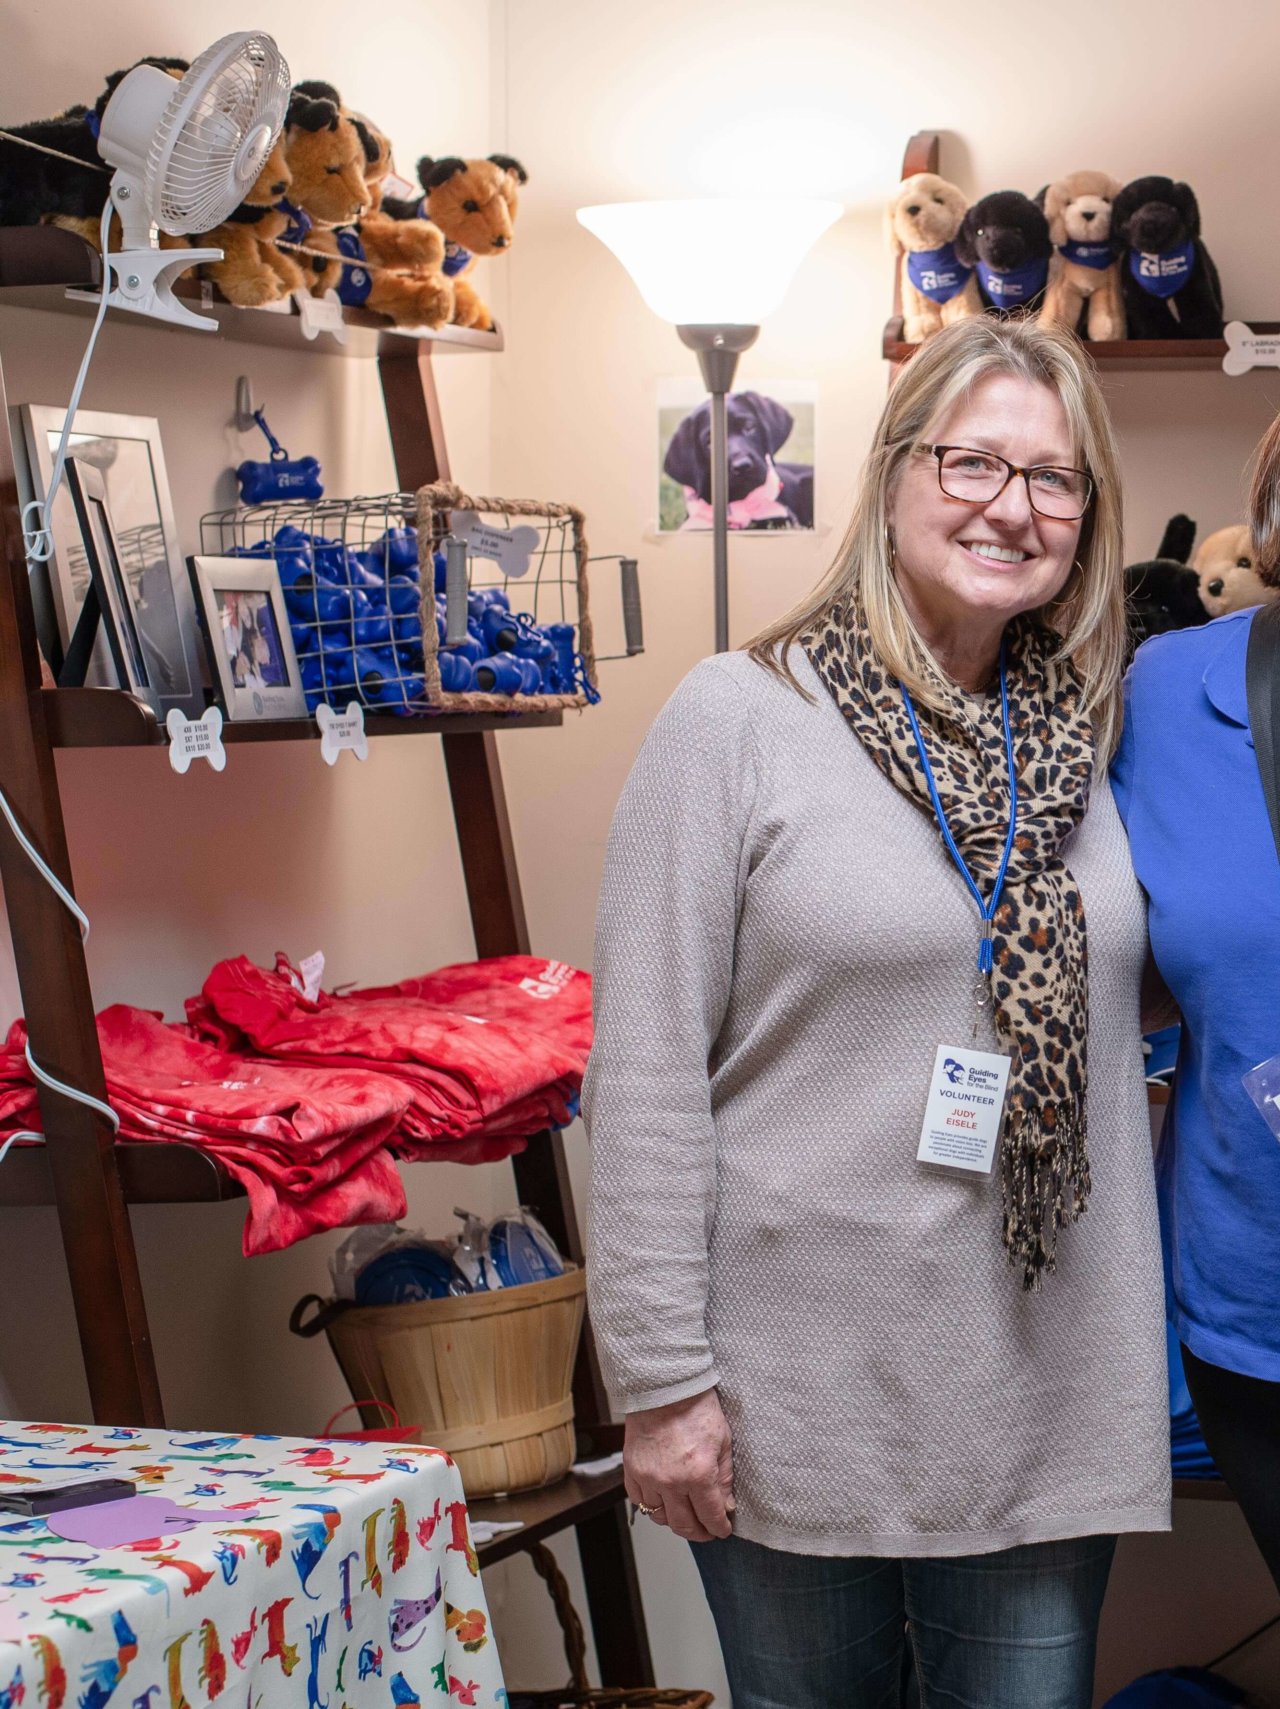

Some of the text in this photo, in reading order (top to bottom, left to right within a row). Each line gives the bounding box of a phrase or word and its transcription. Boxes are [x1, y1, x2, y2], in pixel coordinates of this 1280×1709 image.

[968, 1074, 987, 1083] Eyes
[969, 1067, 999, 1080] Guiding
[984, 1084, 999, 1092] Blind
[939, 1089, 995, 1106] VOLUNTEER
[952, 1108, 976, 1119] JUDY
[946, 1117, 978, 1130] EISELE
